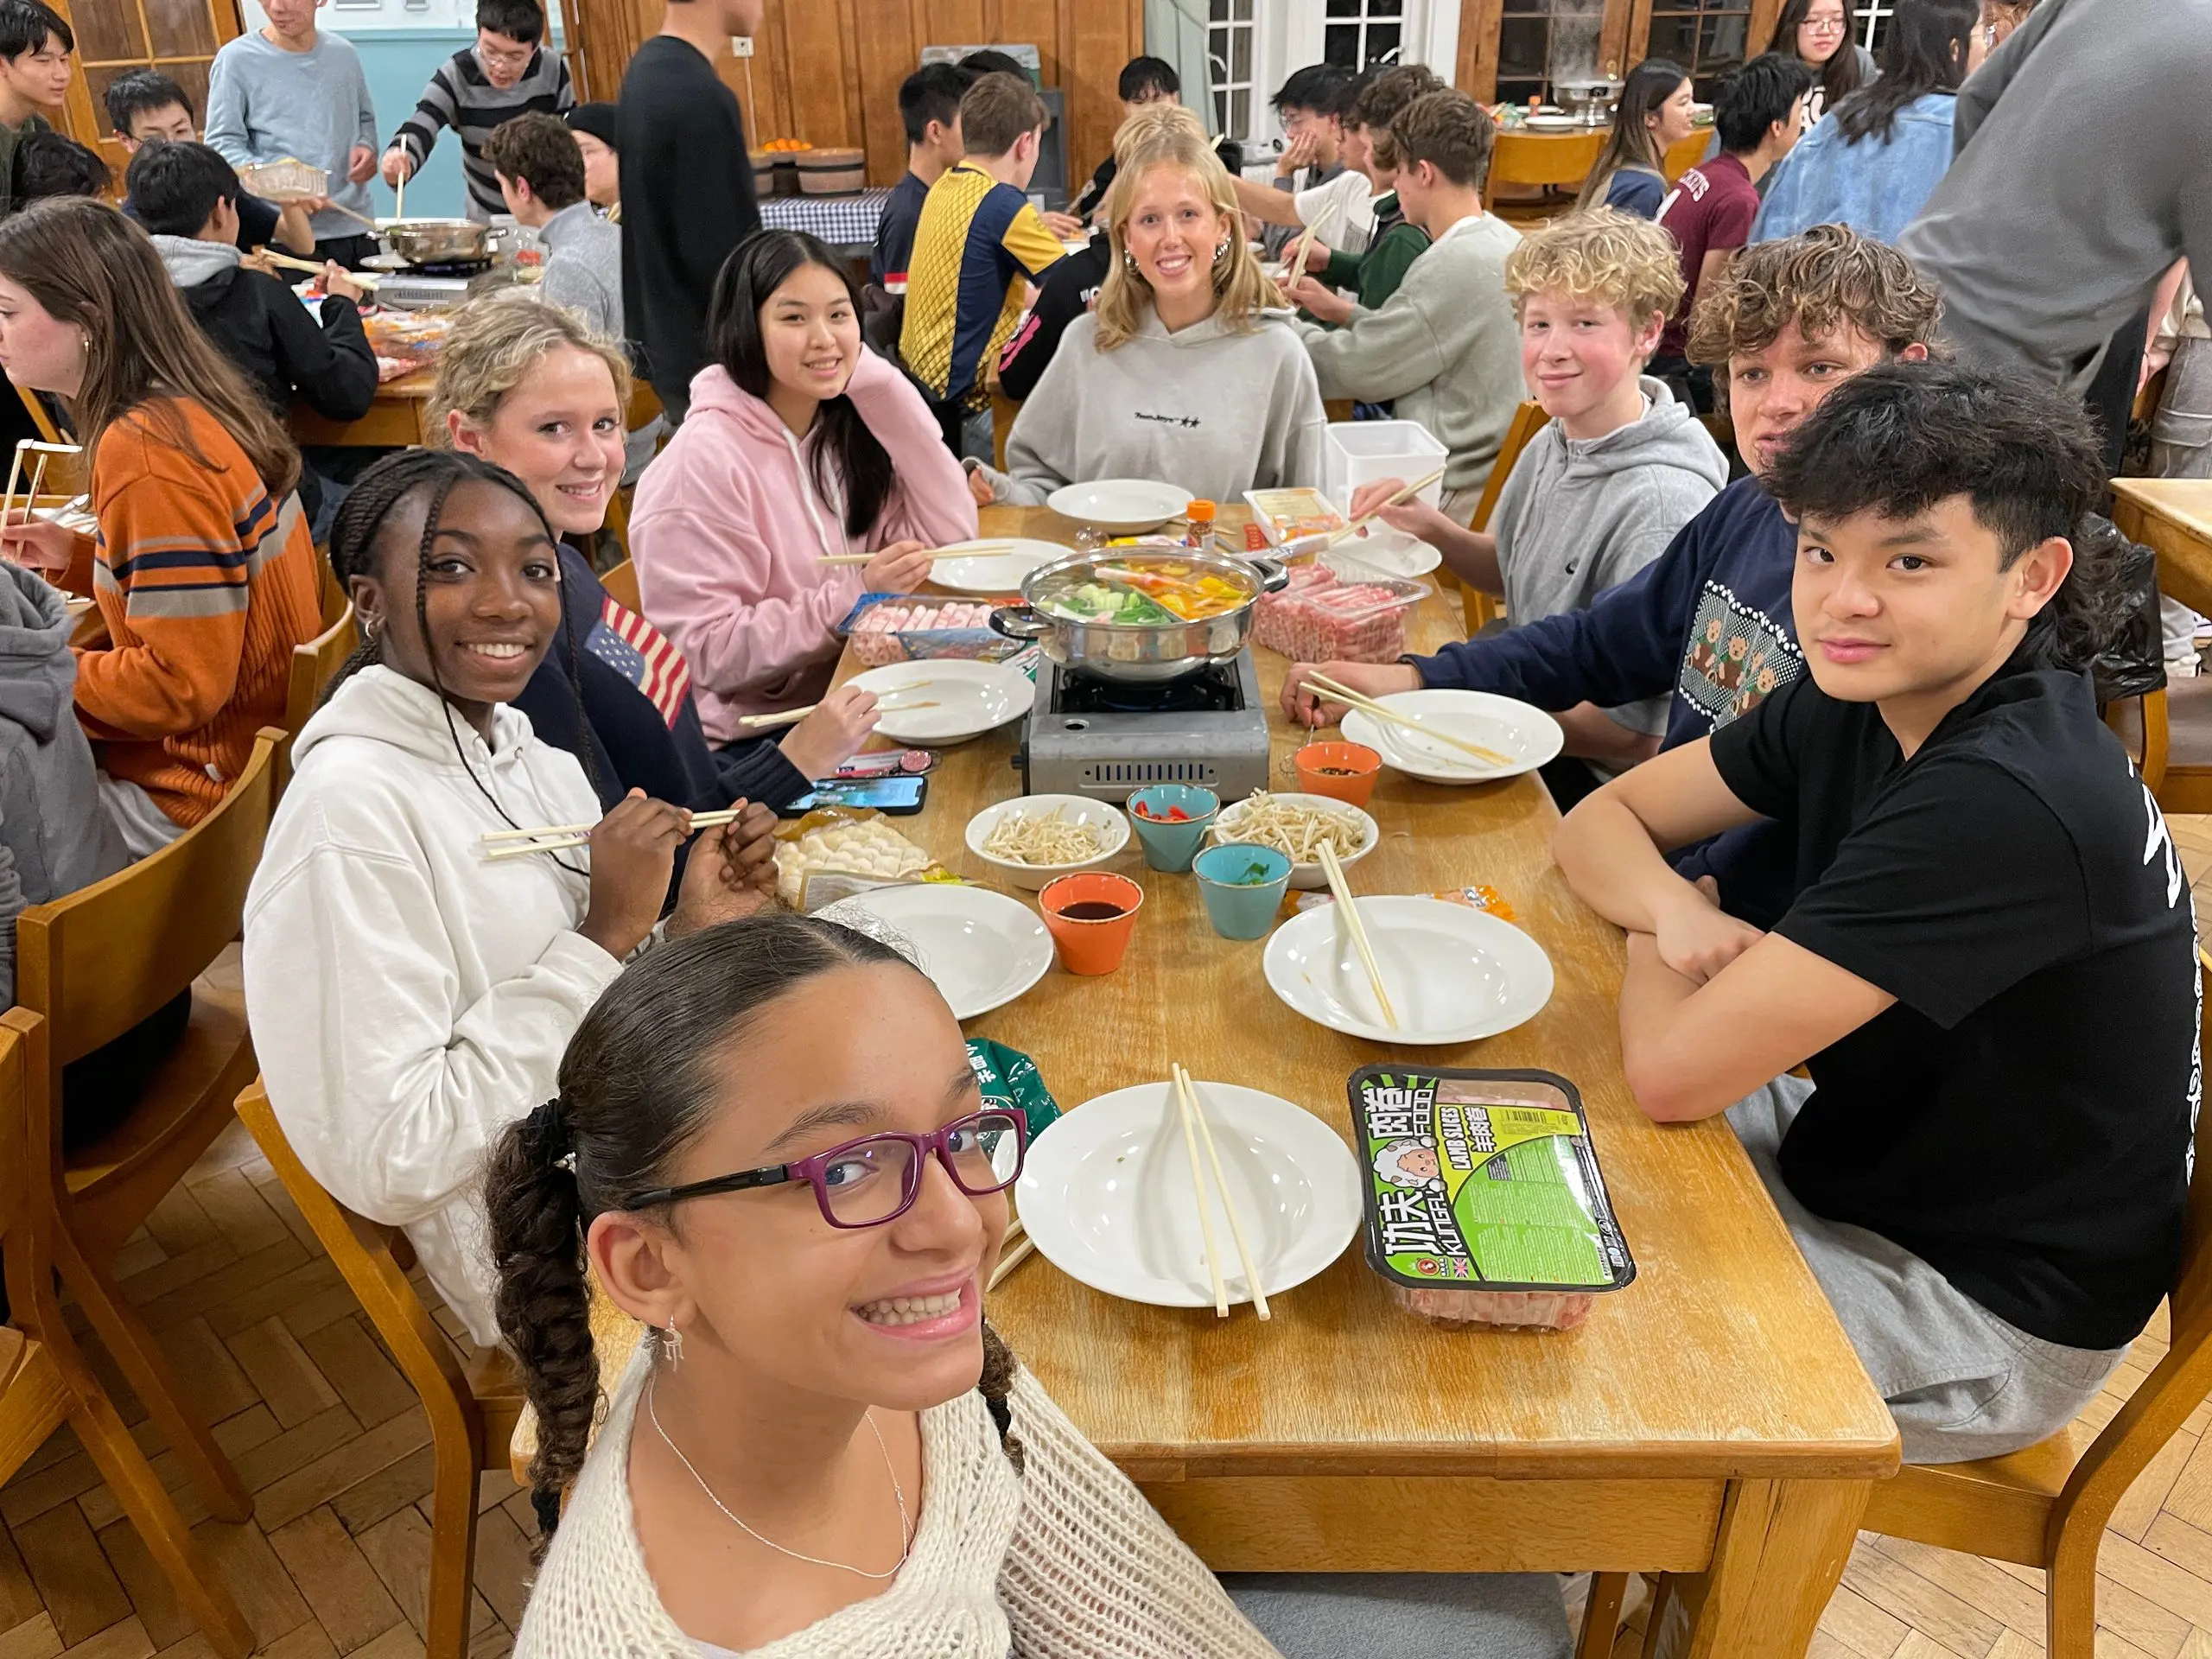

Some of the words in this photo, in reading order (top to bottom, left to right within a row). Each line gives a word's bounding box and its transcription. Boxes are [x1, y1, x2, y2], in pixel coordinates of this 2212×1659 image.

[1363, 1088, 1414, 1139] 肉卷
[1413, 1089, 1434, 1137] FOOD
[1440, 1107, 1465, 1139] SLICES
[1464, 1107, 1496, 1152] 羊肉卷
[1445, 1140, 1472, 1169] LAMB
[1380, 1191, 1442, 1255] 功夫
